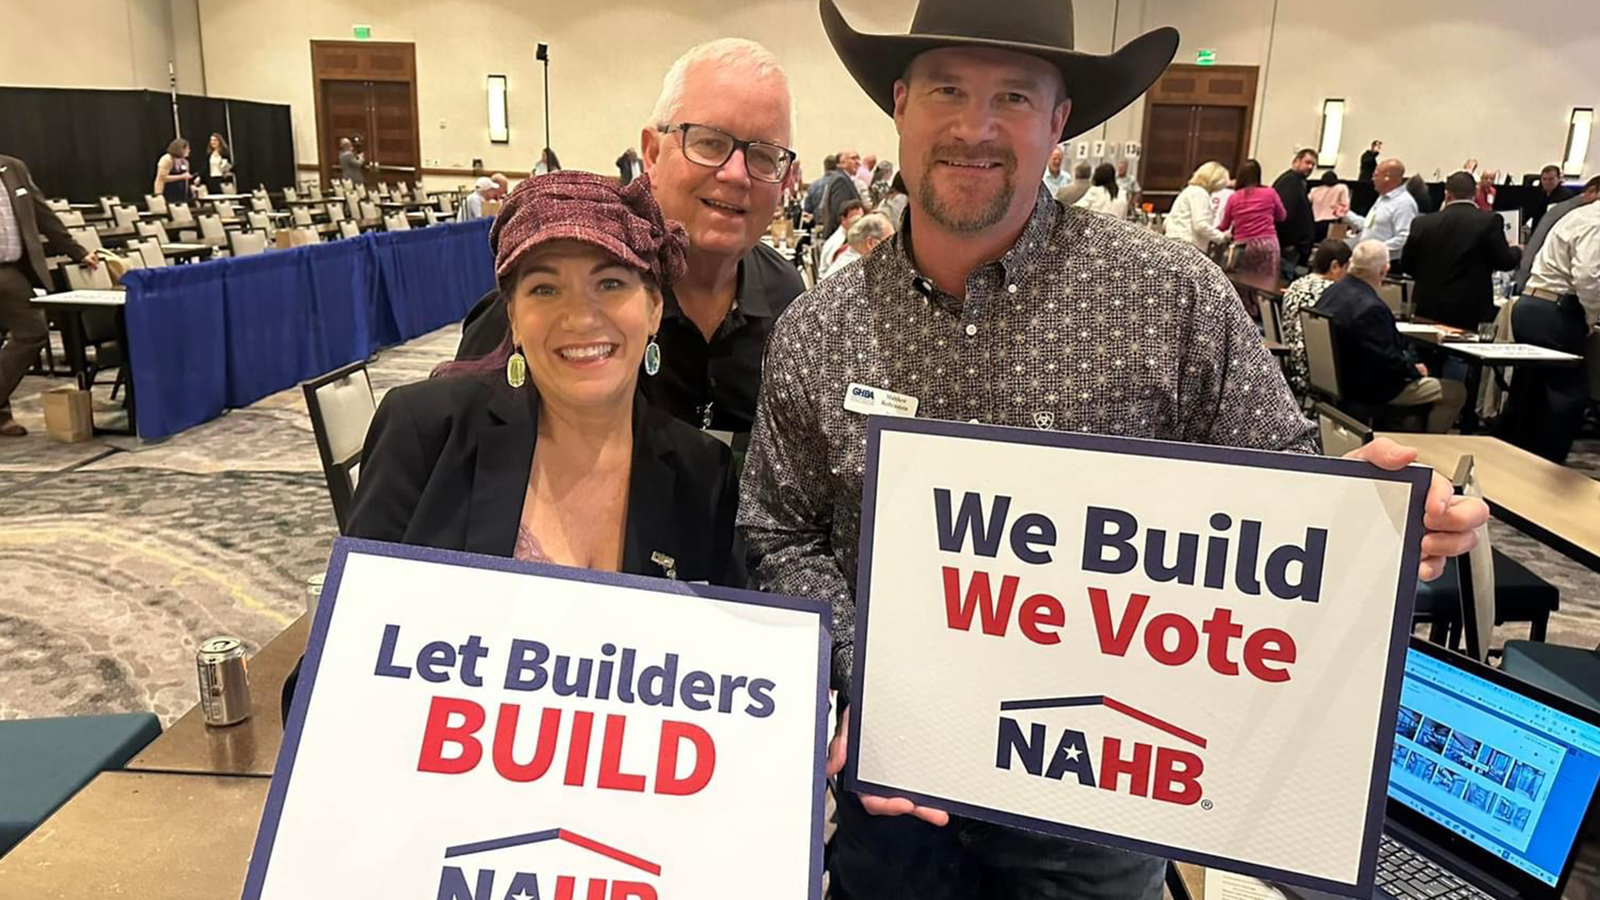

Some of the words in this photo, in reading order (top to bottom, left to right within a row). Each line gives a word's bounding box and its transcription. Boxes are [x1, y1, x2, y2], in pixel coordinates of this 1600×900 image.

[1079, 145, 1086, 156] 2
[1096, 143, 1102, 154] 7
[852, 386, 875, 399] GHBA
[933, 487, 1058, 565] We
[1081, 505, 1329, 604] Build
[373, 623, 489, 688] Let
[503, 638, 776, 719] Builders
[942, 566, 1066, 646] We
[1087, 587, 1297, 683] Vote
[416, 695, 717, 797] BUILD
[995, 716, 1205, 807] NAHB
